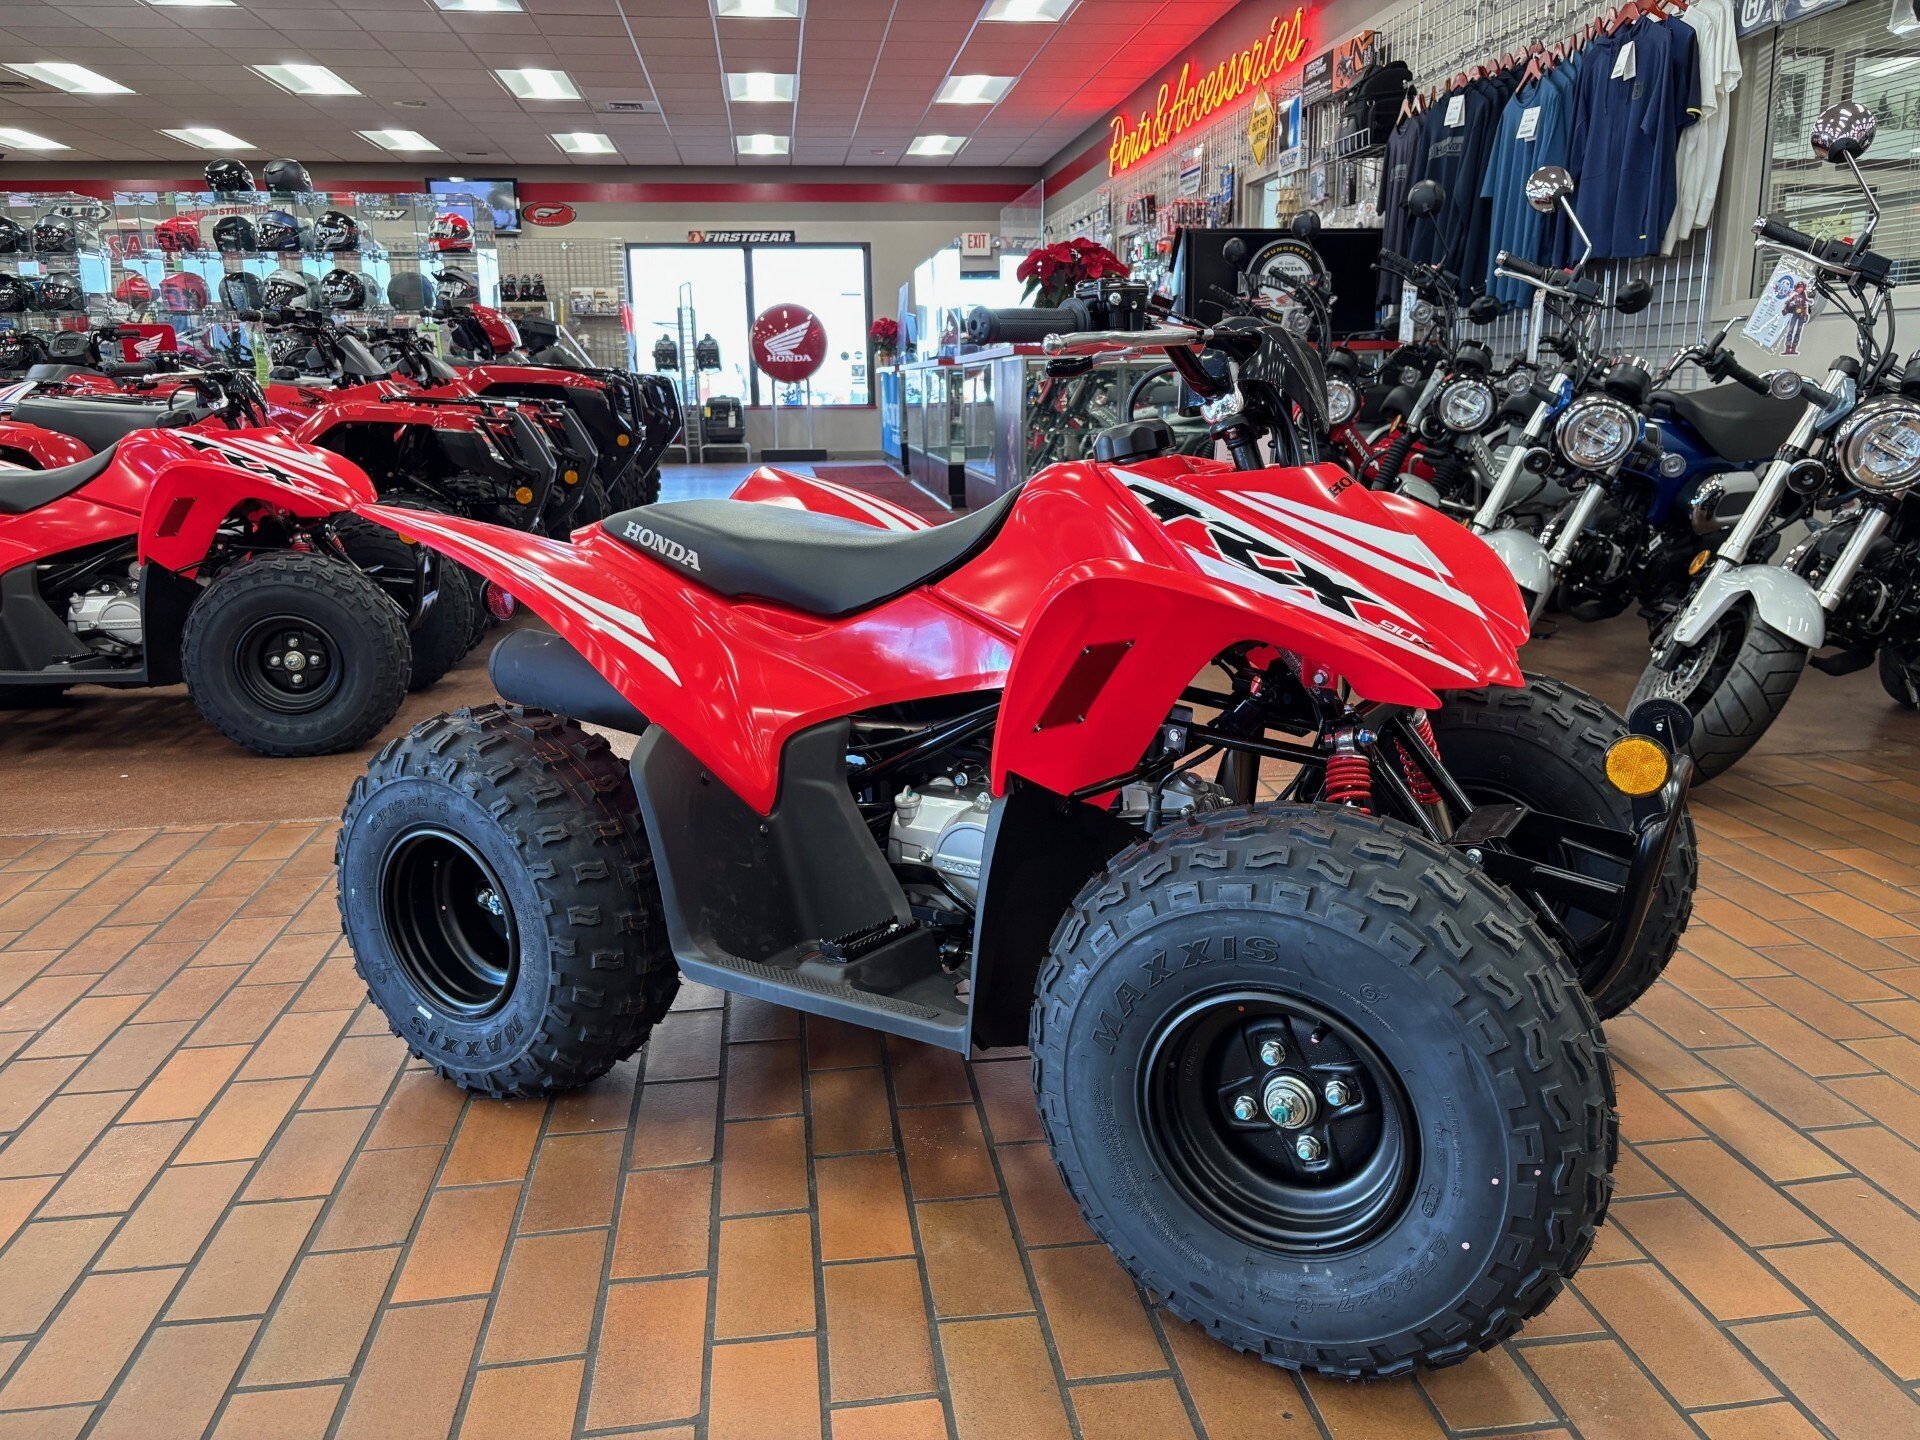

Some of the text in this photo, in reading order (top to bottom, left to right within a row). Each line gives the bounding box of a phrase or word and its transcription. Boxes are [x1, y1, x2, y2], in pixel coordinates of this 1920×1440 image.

[1109, 111, 1152, 177] Parts
[1166, 7, 1309, 134] Accessories
[705, 232, 791, 243] FIRSTGEAR
[968, 234, 986, 249] EXIT
[1267, 312, 1283, 322] SINC
[767, 354, 812, 363] HONDA
[1327, 474, 1355, 499] HO
[622, 520, 702, 572] HONDA
[941, 859, 981, 874] HON
[1090, 935, 1281, 1056] MAXXIS
[409, 1012, 524, 1058] MAXXIS
